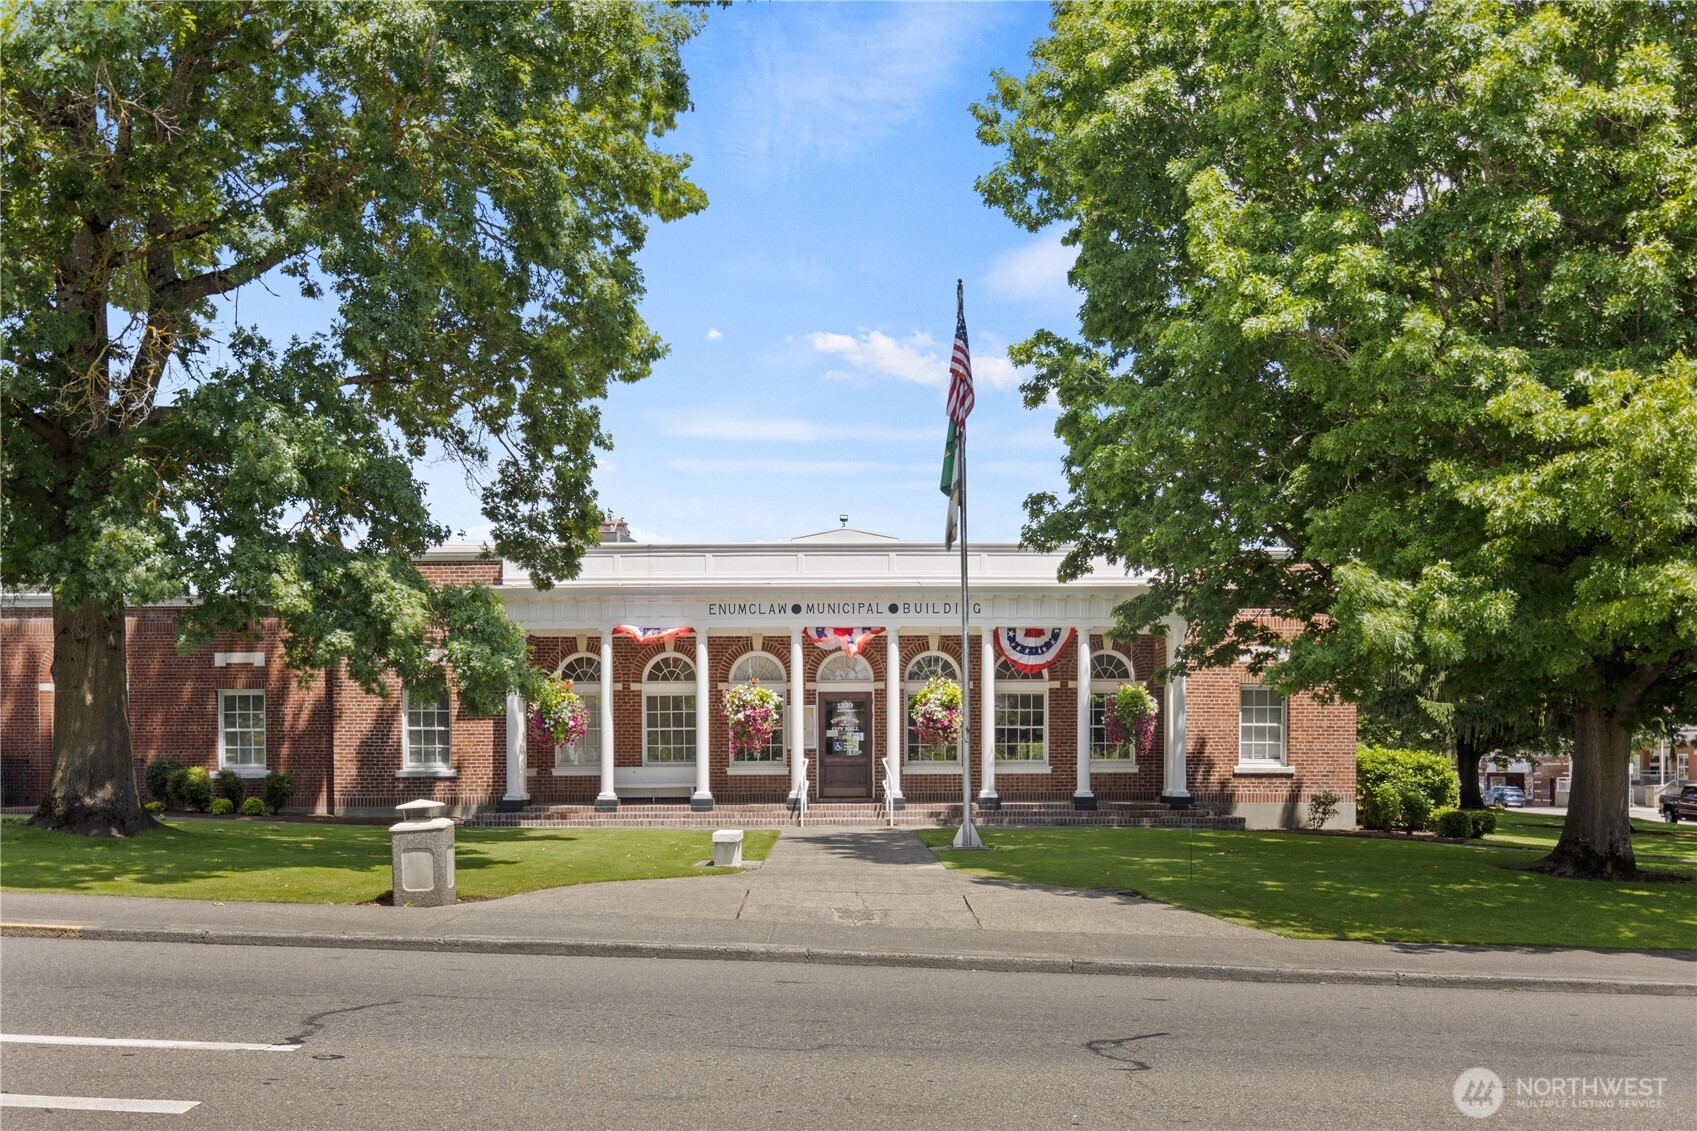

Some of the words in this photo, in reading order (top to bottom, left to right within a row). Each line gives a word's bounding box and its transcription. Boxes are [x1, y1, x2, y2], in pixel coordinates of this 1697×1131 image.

[708, 602, 787, 614] ENUMCLAW
[806, 602, 885, 614] MUNICIPAL
[902, 602, 982, 614] BUILDIG
